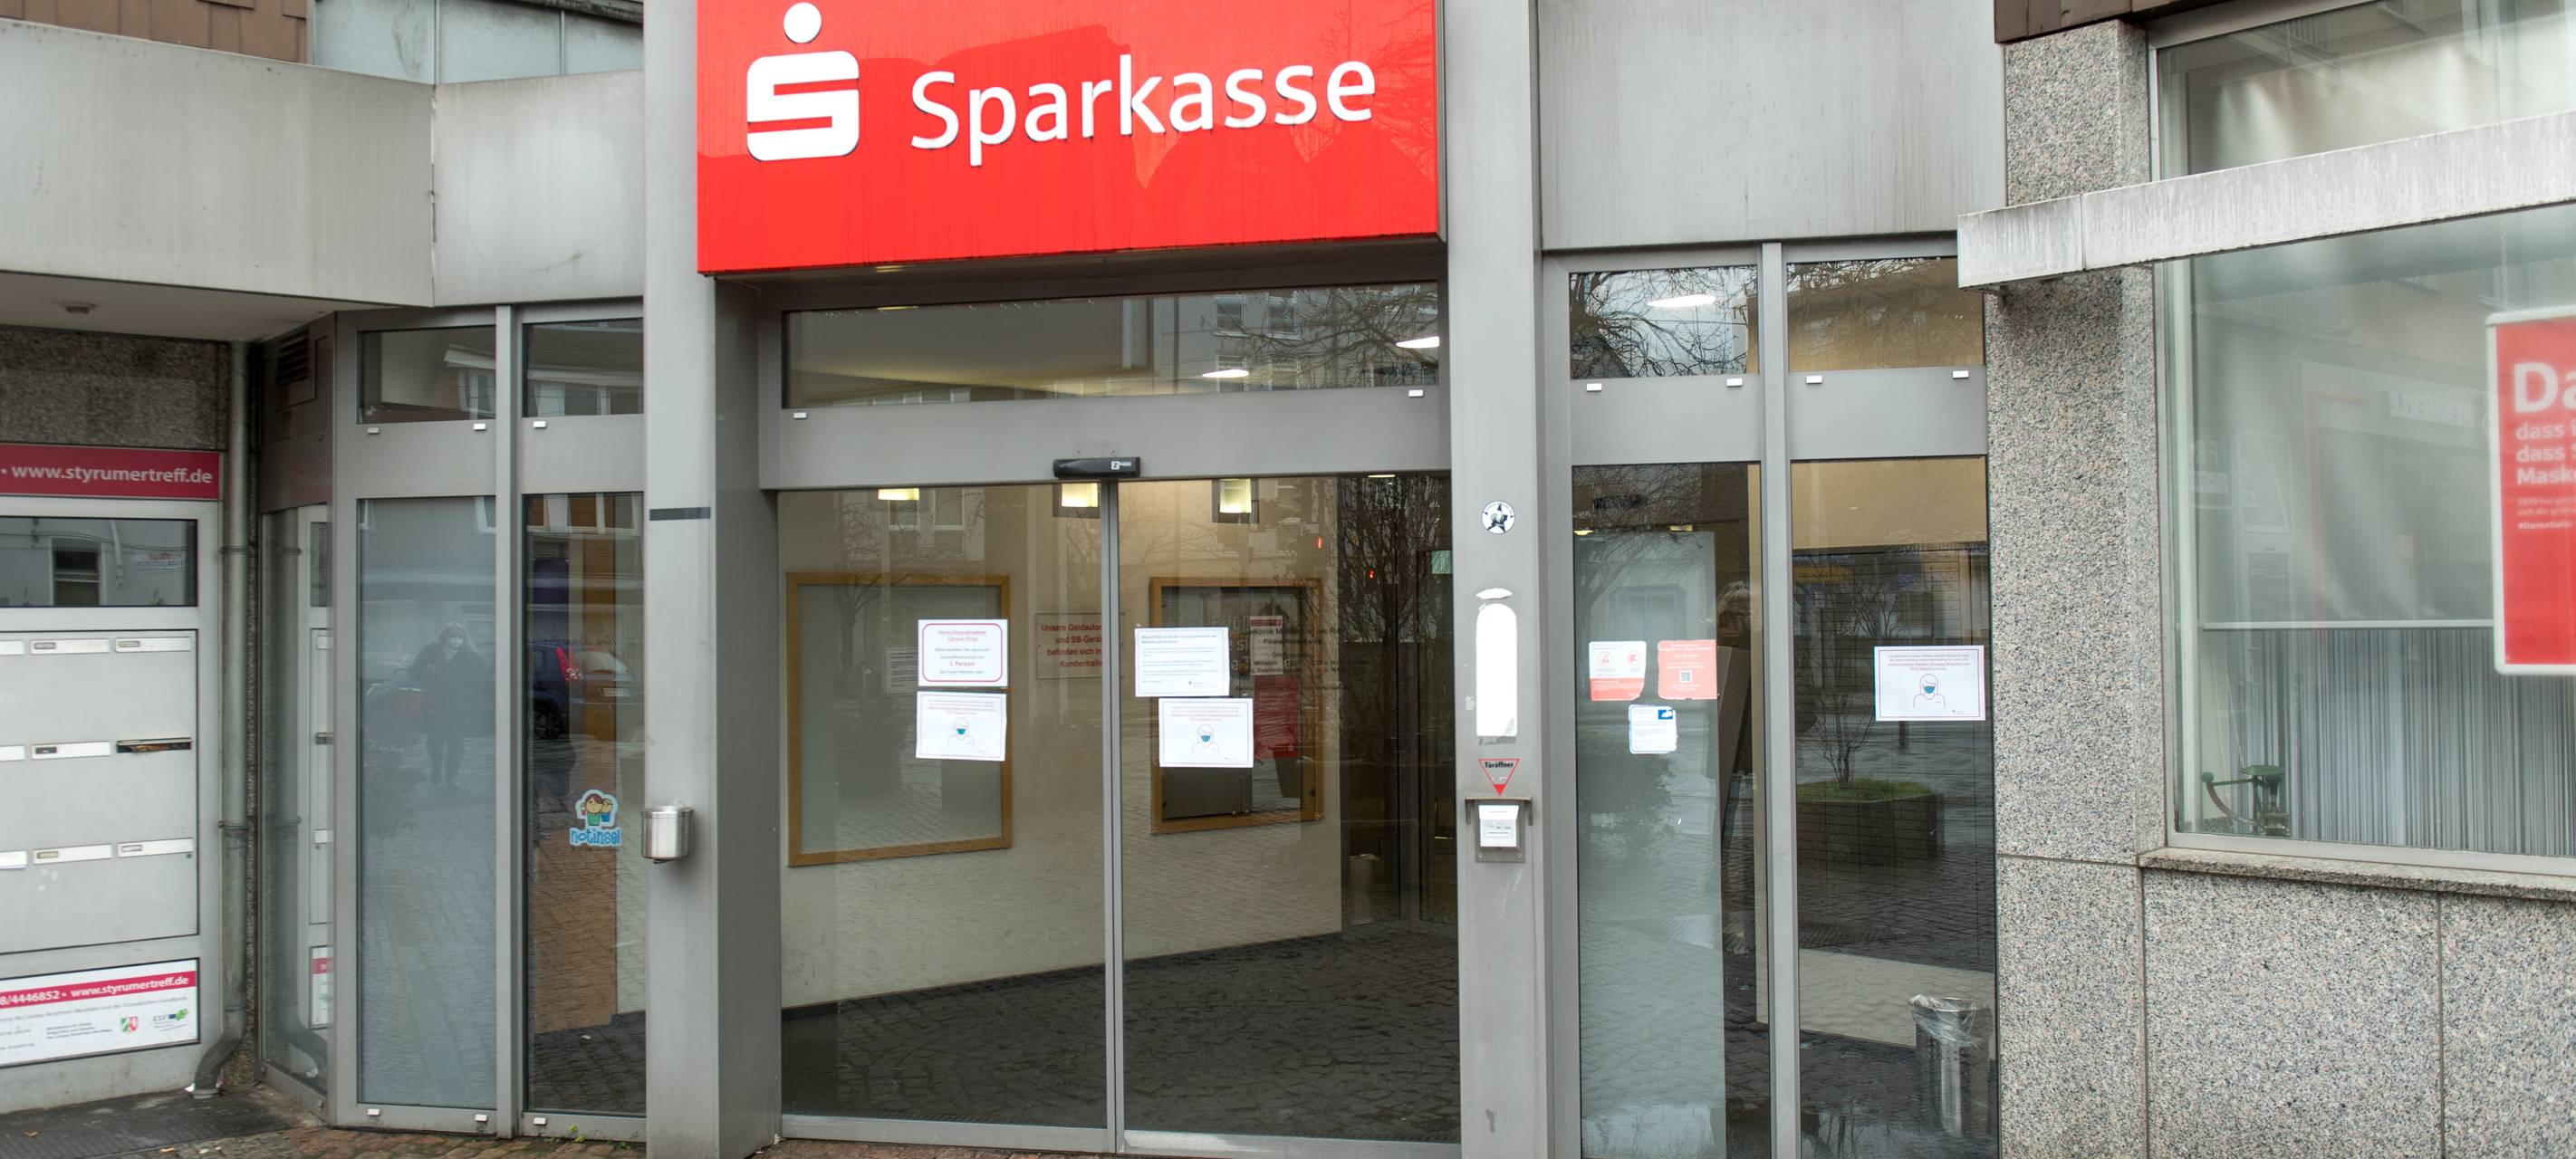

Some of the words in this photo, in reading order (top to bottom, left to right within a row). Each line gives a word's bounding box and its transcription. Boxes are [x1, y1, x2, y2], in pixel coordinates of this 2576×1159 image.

[911, 54, 1376, 167] Sparkasse
[2516, 423, 2565, 440] dass
[2516, 445, 2566, 462] dass
[11, 465, 213, 484] www.styrumertreff.de
[1485, 761, 1514, 769] Türöffner
[0, 990, 61, 1006] 8/4446852
[71, 976, 189, 997] www.styrumertreff.de
